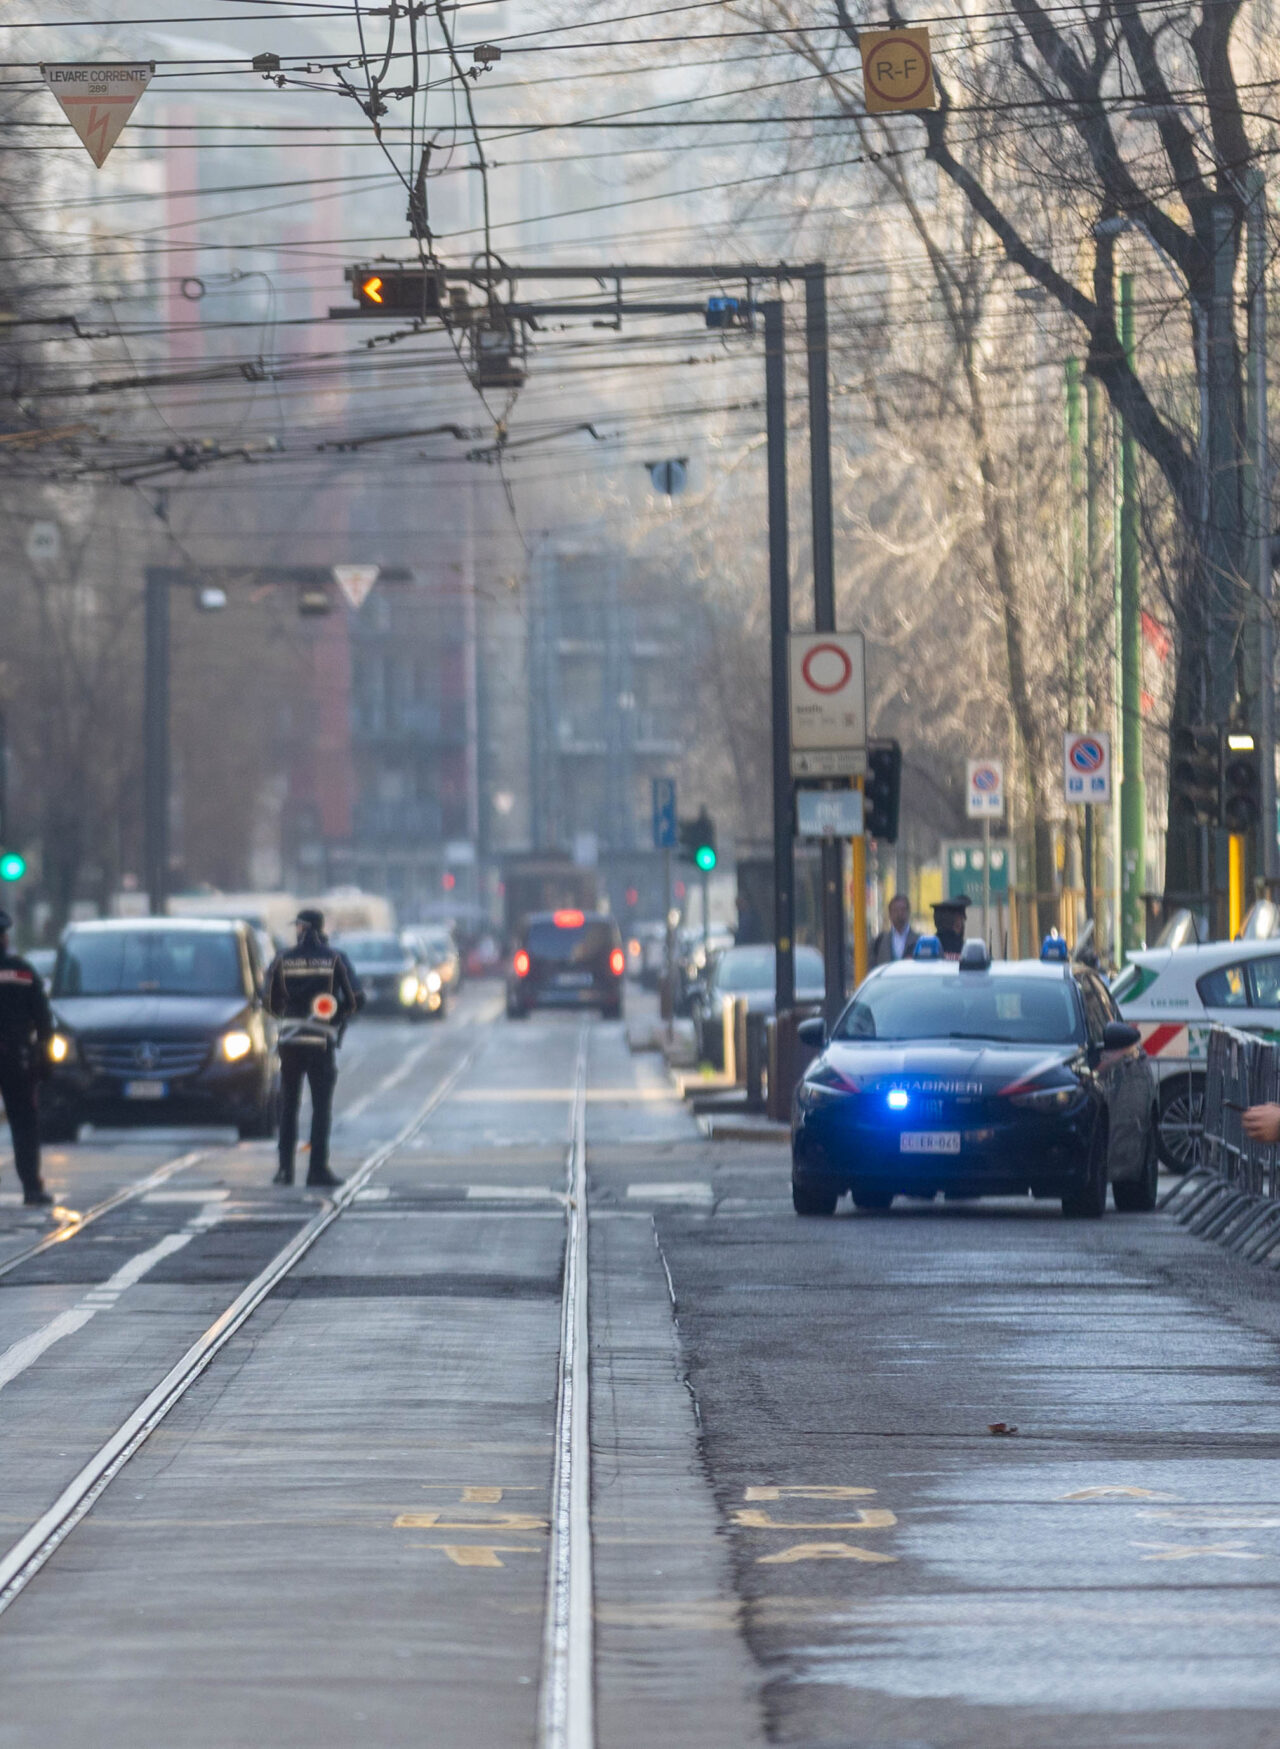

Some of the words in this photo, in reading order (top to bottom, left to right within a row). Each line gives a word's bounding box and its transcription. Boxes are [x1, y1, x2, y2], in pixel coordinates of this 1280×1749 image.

[50, 71, 89, 82] LEVARE
[90, 70, 146, 82] CORRENTE
[876, 58, 918, 81] R-F
[89, 84, 107, 93] 289
[422, 1485, 1185, 1503] TRA
[404, 1543, 1268, 1567] TAX
